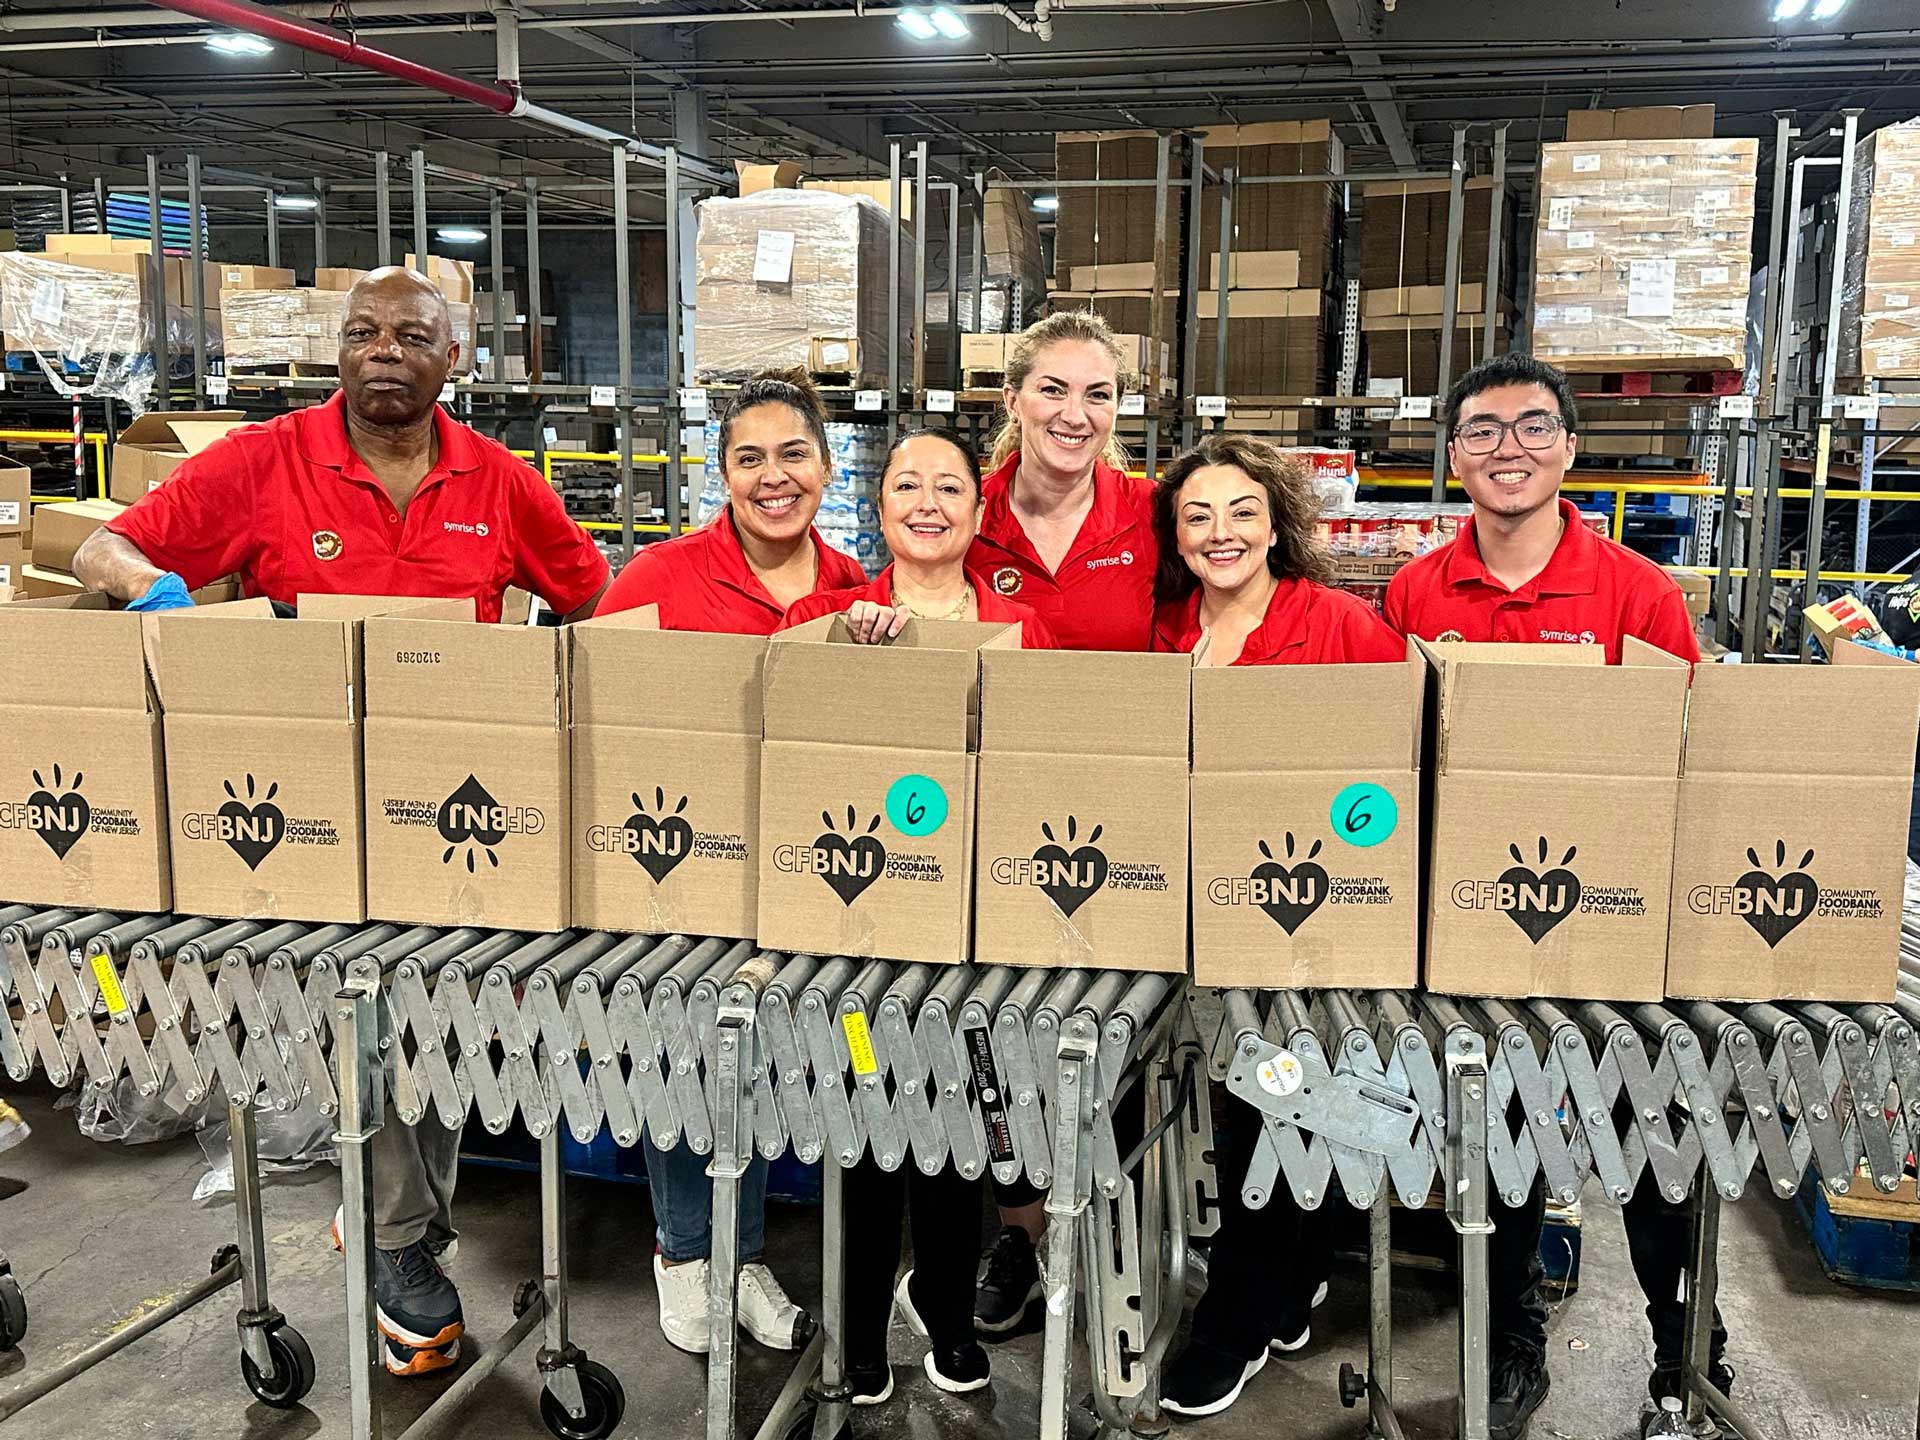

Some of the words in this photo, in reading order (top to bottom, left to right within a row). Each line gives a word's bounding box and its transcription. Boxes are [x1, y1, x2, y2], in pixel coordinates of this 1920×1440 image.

[444, 522, 476, 534] symrise
[1086, 556, 1120, 570] symrise
[1540, 630, 1578, 642] symrise
[396, 652, 440, 663] 3120269
[382, 798, 407, 807] JERSEY
[407, 800, 425, 809] NEW
[425, 801, 437, 809] OF
[90, 807, 133, 817] COMMUNITY
[385, 807, 437, 819] FOODBANK
[906, 792, 926, 825] 6
[1345, 795, 1372, 833] 6
[0, 802, 80, 832] CFBNJ
[91, 816, 138, 827] FOODBANK
[286, 818, 332, 827] COMMUNITY
[390, 818, 437, 827] COMMUNITY
[449, 803, 546, 834] CFBNJ
[102, 826, 117, 834] NEW
[118, 828, 141, 836] JERSEY
[182, 812, 274, 843] CFBNJ
[286, 826, 337, 837] FOODBANK
[296, 836, 314, 845] NEW
[315, 837, 340, 846] JERSEY
[586, 824, 681, 856] CFBNJ
[694, 832, 742, 842] COMMUNITY
[694, 841, 746, 852] FOODBANK
[705, 850, 723, 859] NEW
[724, 852, 749, 861] JERSEY
[773, 844, 873, 878] CFBNJ
[886, 853, 937, 863] COMMUNITY
[886, 861, 942, 873] FOODBANK
[990, 857, 1095, 888] CFBNJ
[1109, 862, 1160, 872] COMMUNITY
[886, 870, 897, 879] OF
[898, 871, 917, 880] NEW
[918, 873, 944, 882] JERSEY
[1109, 871, 1166, 883] FOODBANK
[1330, 877, 1384, 886] COMMUNITY
[1108, 880, 1120, 889] OF
[1120, 881, 1141, 890] NEW
[1142, 882, 1168, 891] JERSEY
[1330, 886, 1390, 896] FOODBANK
[1581, 886, 1639, 896] COMMUNITY
[1208, 878, 1316, 905] CFBNJ
[1451, 880, 1566, 913] CFBNJ
[1819, 889, 1876, 898] COMMUNITY
[1330, 896, 1342, 904] OF
[1343, 896, 1365, 904] NEW
[1365, 896, 1394, 905] JERSEY
[1581, 895, 1645, 907] FOODBANK
[1688, 885, 1804, 917] CFBNJ
[1819, 898, 1881, 910] FOODBANK
[1580, 905, 1594, 914] OF
[1594, 905, 1617, 915] NEW
[1617, 907, 1647, 916] JERSEY
[1818, 908, 1831, 917] OF
[1832, 908, 1854, 918] NEW
[1855, 909, 1884, 919] JERSEY
[977, 1072, 988, 1088] 200
